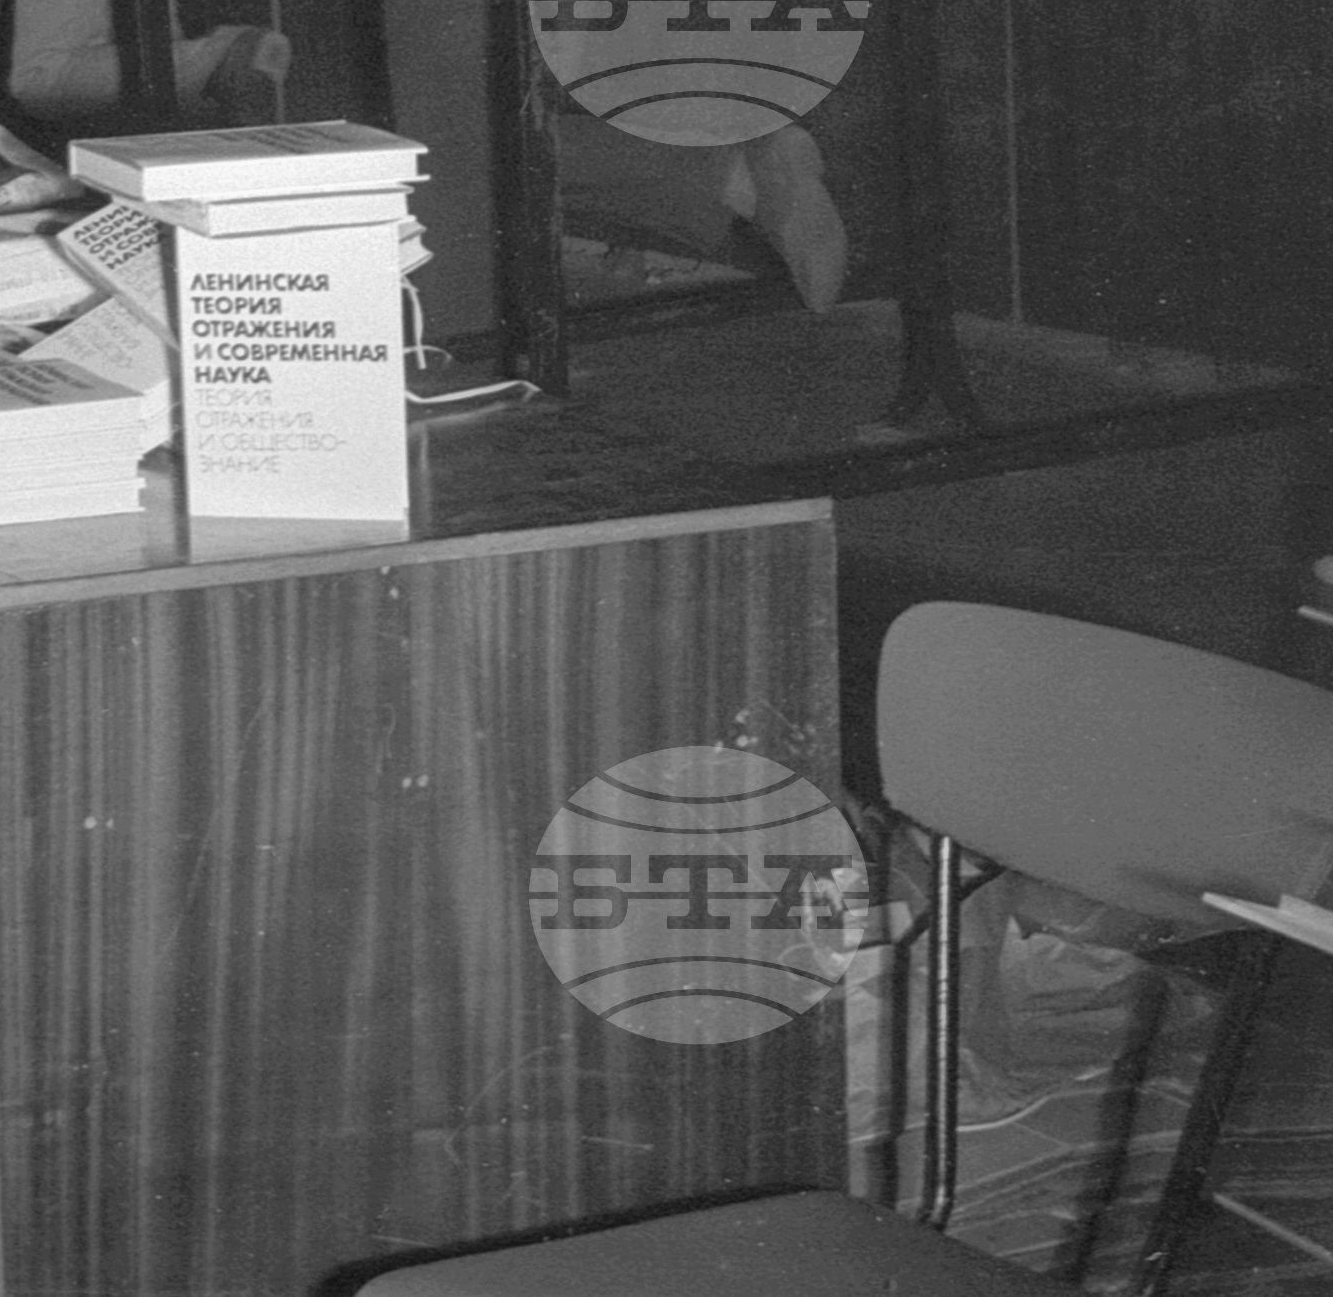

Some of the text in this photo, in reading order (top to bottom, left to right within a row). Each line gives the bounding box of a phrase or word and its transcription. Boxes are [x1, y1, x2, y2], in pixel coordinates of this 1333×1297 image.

[190, 273, 329, 291] ЛЕНИНСКАЯ
[191, 297, 282, 314] ТЕОРИЯ
[192, 320, 336, 338] ОТРАЖЕНИЯ
[194, 343, 388, 361] И СОВРЕМЕННАЯ
[194, 366, 272, 383] НАУКА
[194, 388, 272, 406] ТЕОРИЯ
[196, 411, 313, 428] ОТРАЖЕНИЯ
[199, 434, 214, 450] И
[200, 454, 281, 473] ЗНАНИЕ
